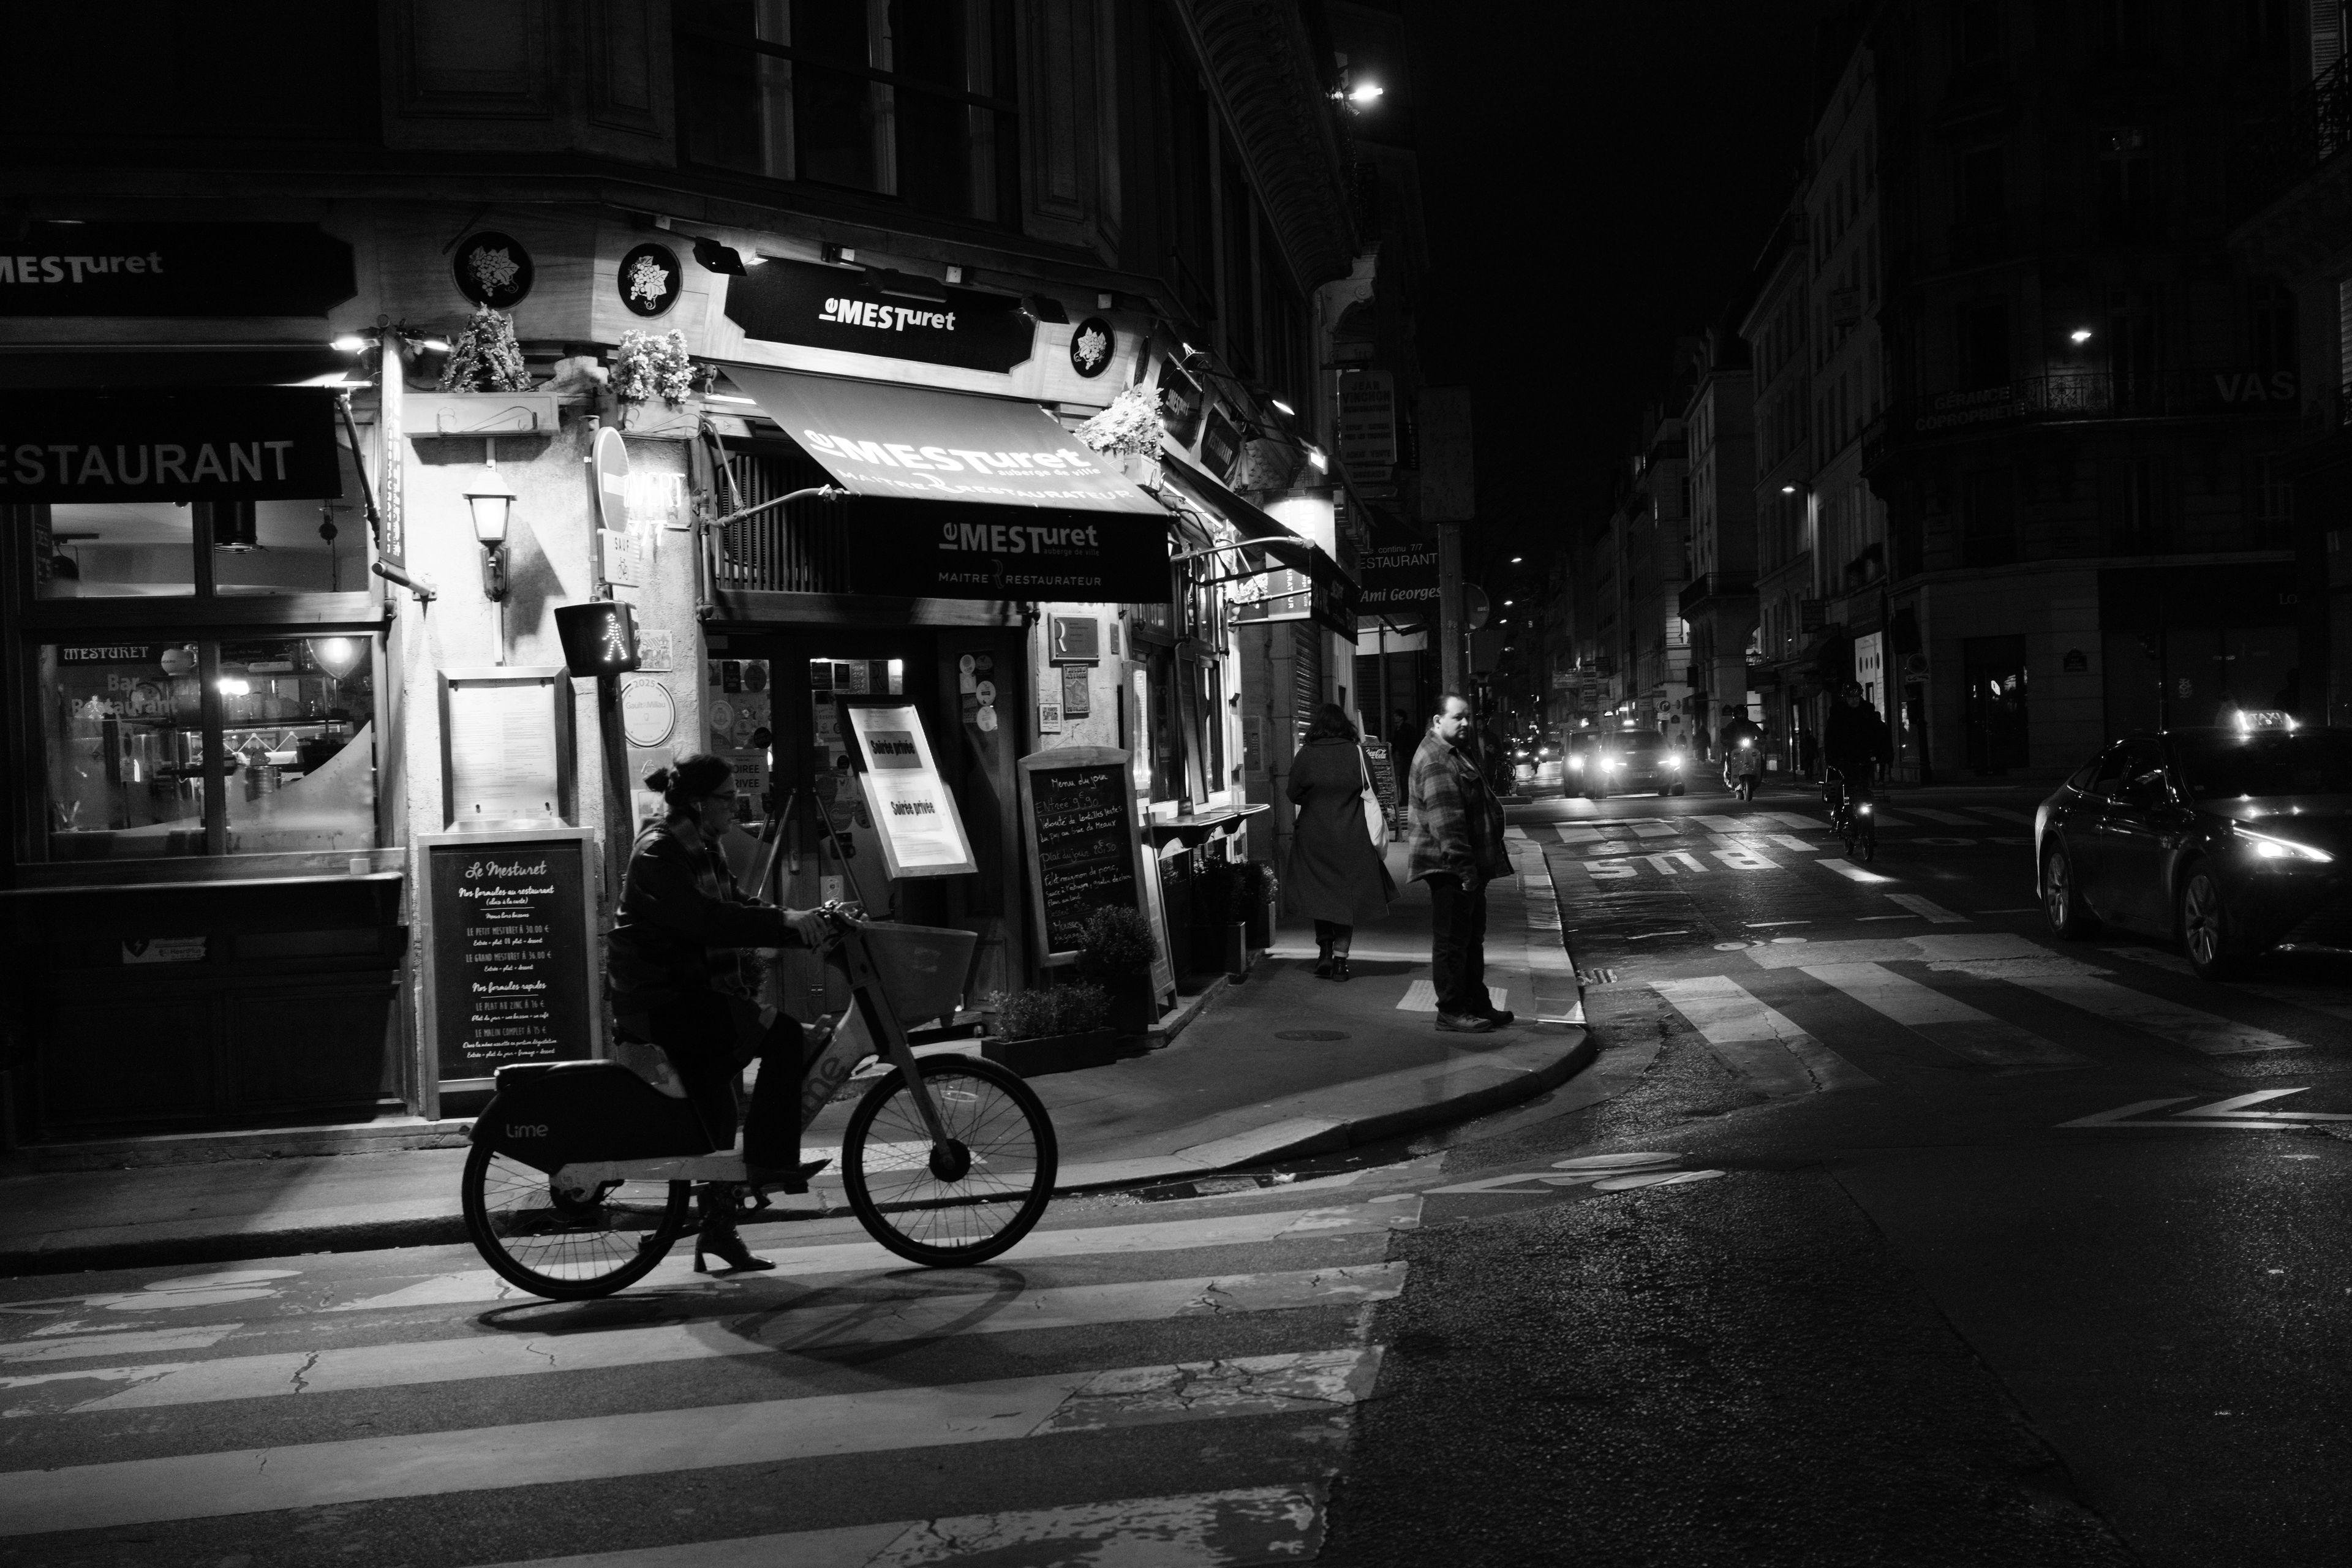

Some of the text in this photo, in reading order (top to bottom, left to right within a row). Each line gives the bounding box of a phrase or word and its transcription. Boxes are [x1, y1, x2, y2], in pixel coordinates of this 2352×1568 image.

[1352, 380, 1380, 390] JEAN
[2214, 370, 2296, 402] VAS
[1934, 386, 2010, 410] GÉRANCE
[0, 440, 294, 484] STAURANT
[997, 469, 1050, 478] auberge
[1072, 467, 1101, 475] ville
[836, 469, 929, 490] MAITRE
[956, 486, 1134, 500] RESTAURATEUR
[615, 537, 630, 551] SAUF
[1044, 548, 1072, 556] auberge
[1378, 545, 1406, 554] continu
[1410, 543, 1423, 552] 7/7
[1360, 553, 1438, 570] ESTAURANT
[938, 571, 989, 584] MAITRE
[1005, 574, 1102, 587] RESTAURATEUR
[1360, 587, 1441, 603] Ami Georges
[64, 646, 149, 660] MESTURET
[107, 674, 140, 692] Bar
[634, 679, 656, 688] 2025
[72, 698, 178, 717] Rtaurant
[870, 739, 915, 756] Soirée privée
[1051, 778, 1076, 791] Menu
[1078, 774, 1090, 785] du
[891, 800, 936, 817] Soirée privée
[465, 860, 547, 880] Le Mesturet
[1583, 848, 1782, 880] BUS
[459, 888, 473, 897] Nos
[475, 886, 506, 899] formules
[517, 885, 554, 895] restaurant
[467, 927, 473, 936] LE
[475, 927, 490, 936] PETIT
[492, 925, 519, 935] MESTURET
[466, 954, 472, 962] LE
[475, 953, 492, 962] GRAND
[494, 952, 520, 961] MESTURET
[472, 980, 547, 993] Nos formules rapides
[476, 1003, 483, 1011] LE
[484, 1002, 497, 1011] PLAT
[510, 1001, 522, 1009] ZINC
[475, 1029, 481, 1038] LE
[483, 1028, 501, 1037] MALIN
[502, 1027, 525, 1036] COMPLET
[506, 1123, 548, 1139] Lime
